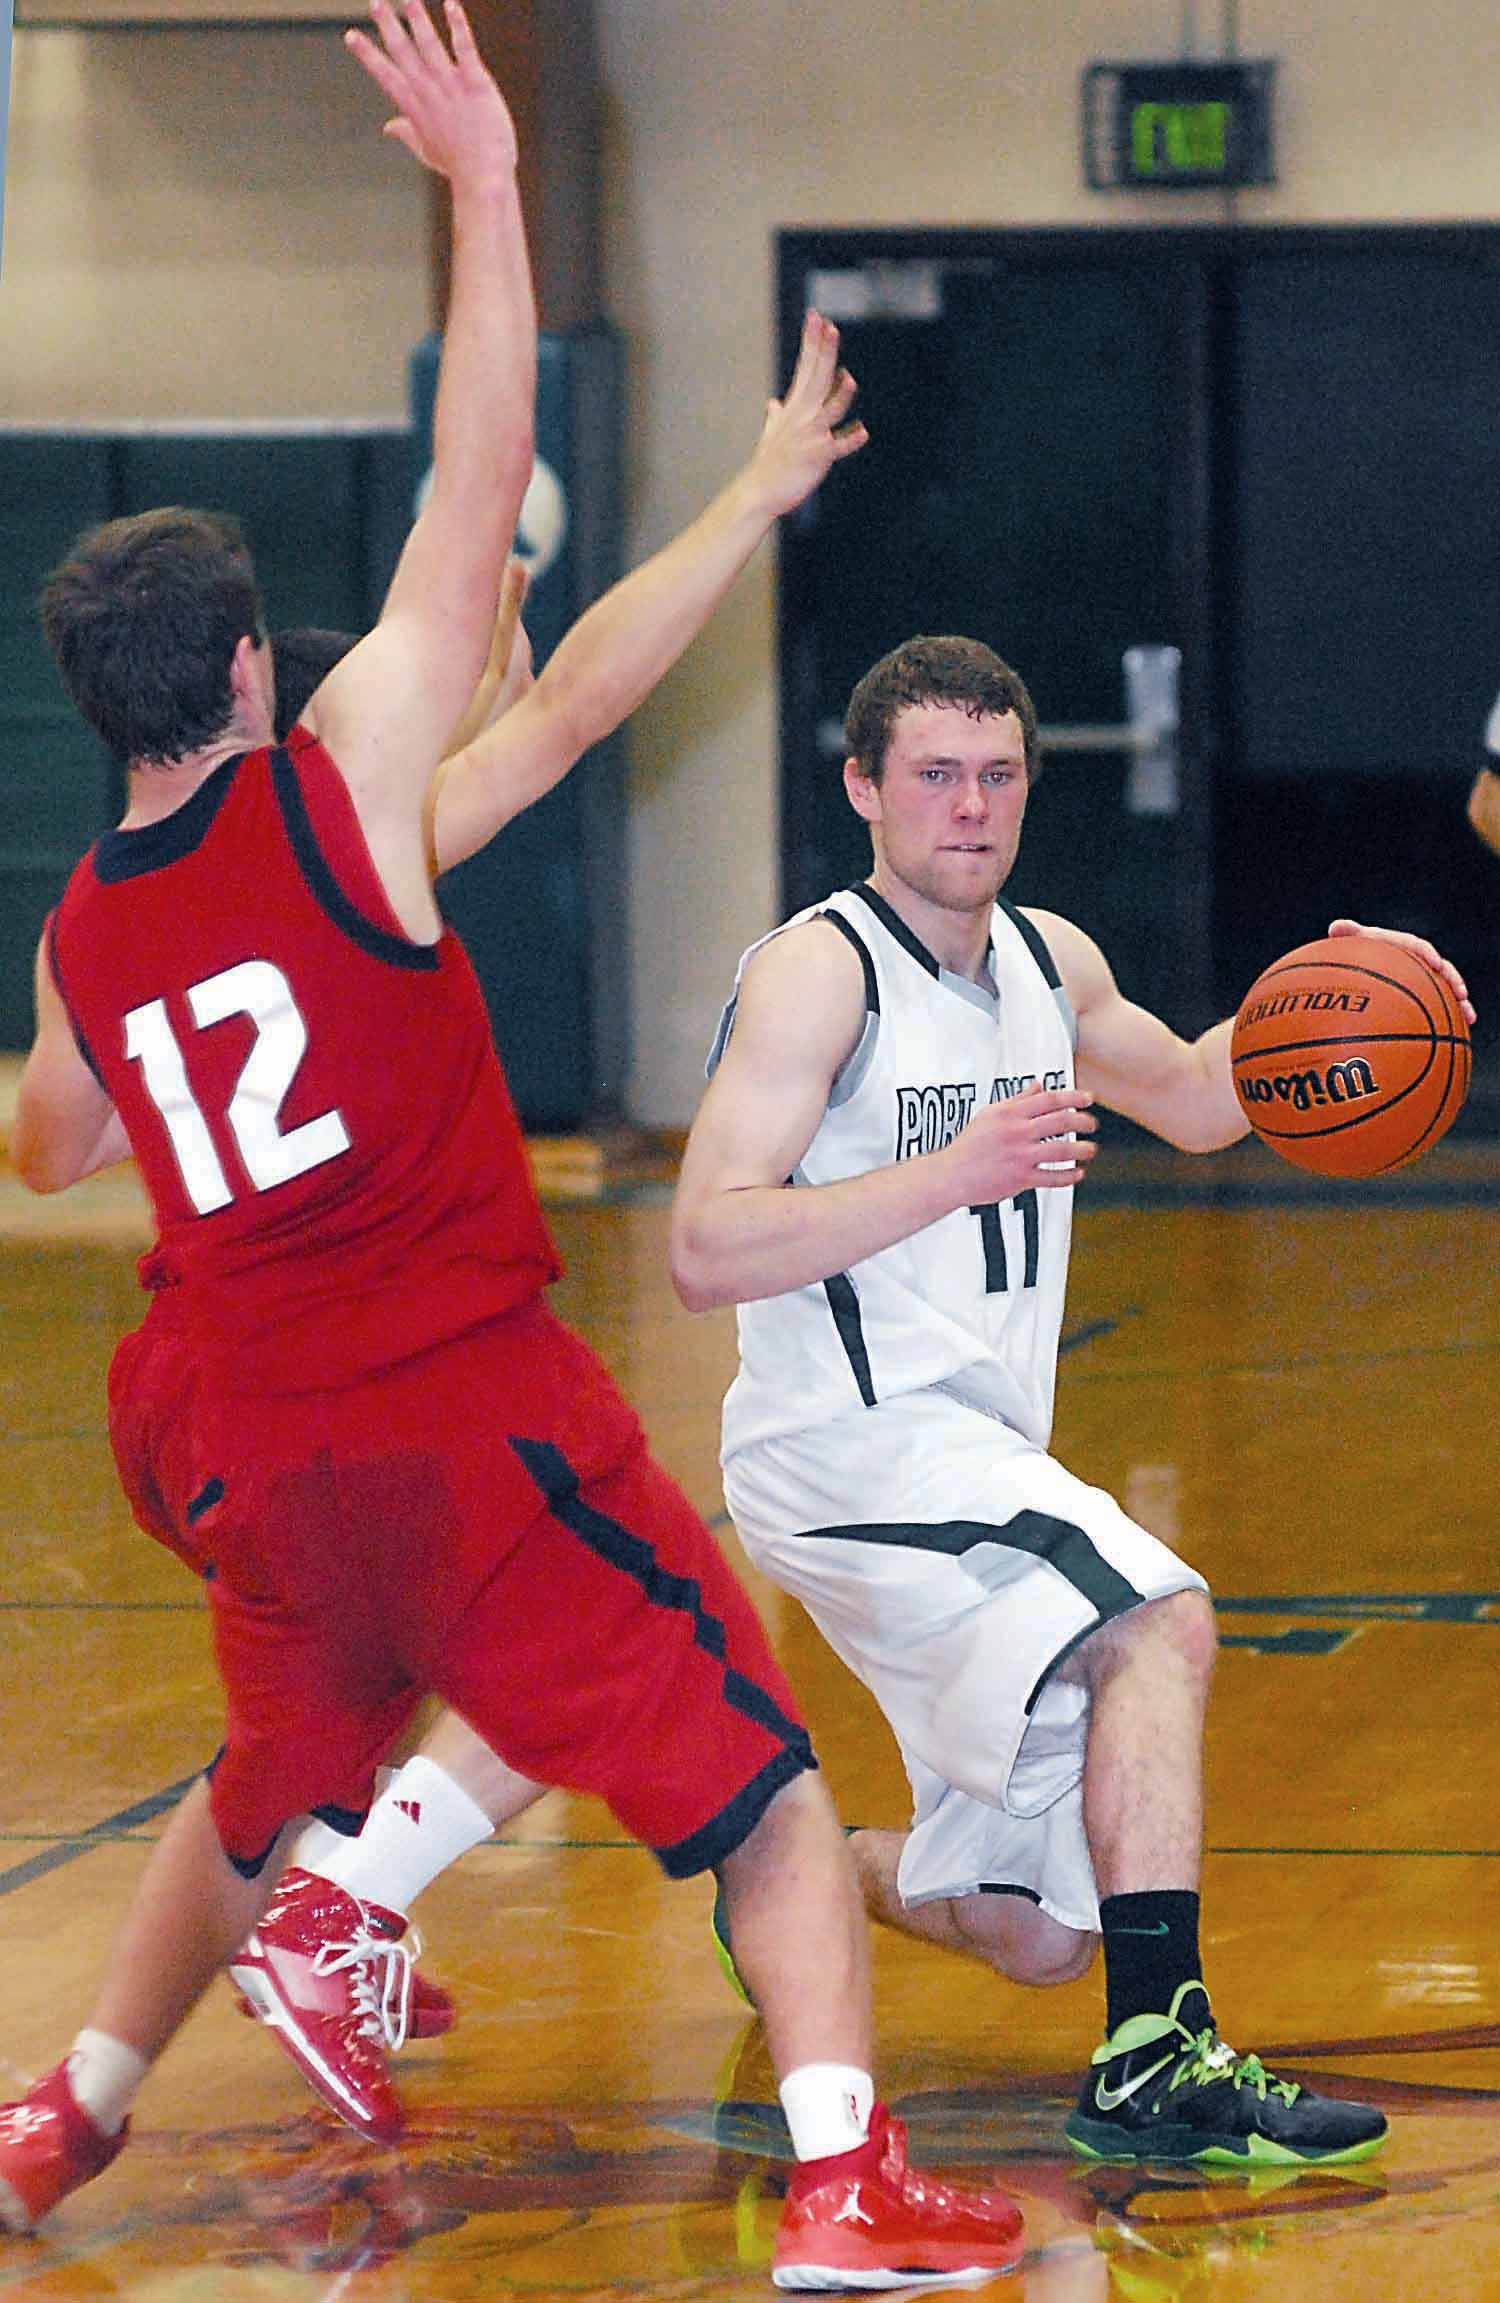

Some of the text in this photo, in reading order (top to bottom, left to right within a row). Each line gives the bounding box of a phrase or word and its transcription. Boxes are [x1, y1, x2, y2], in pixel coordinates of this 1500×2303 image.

[123, 959, 352, 1218] 12
[896, 1083, 976, 1162] PORT
[1239, 1056, 1382, 1112] Wilson
[968, 1187, 1040, 1294] 11
